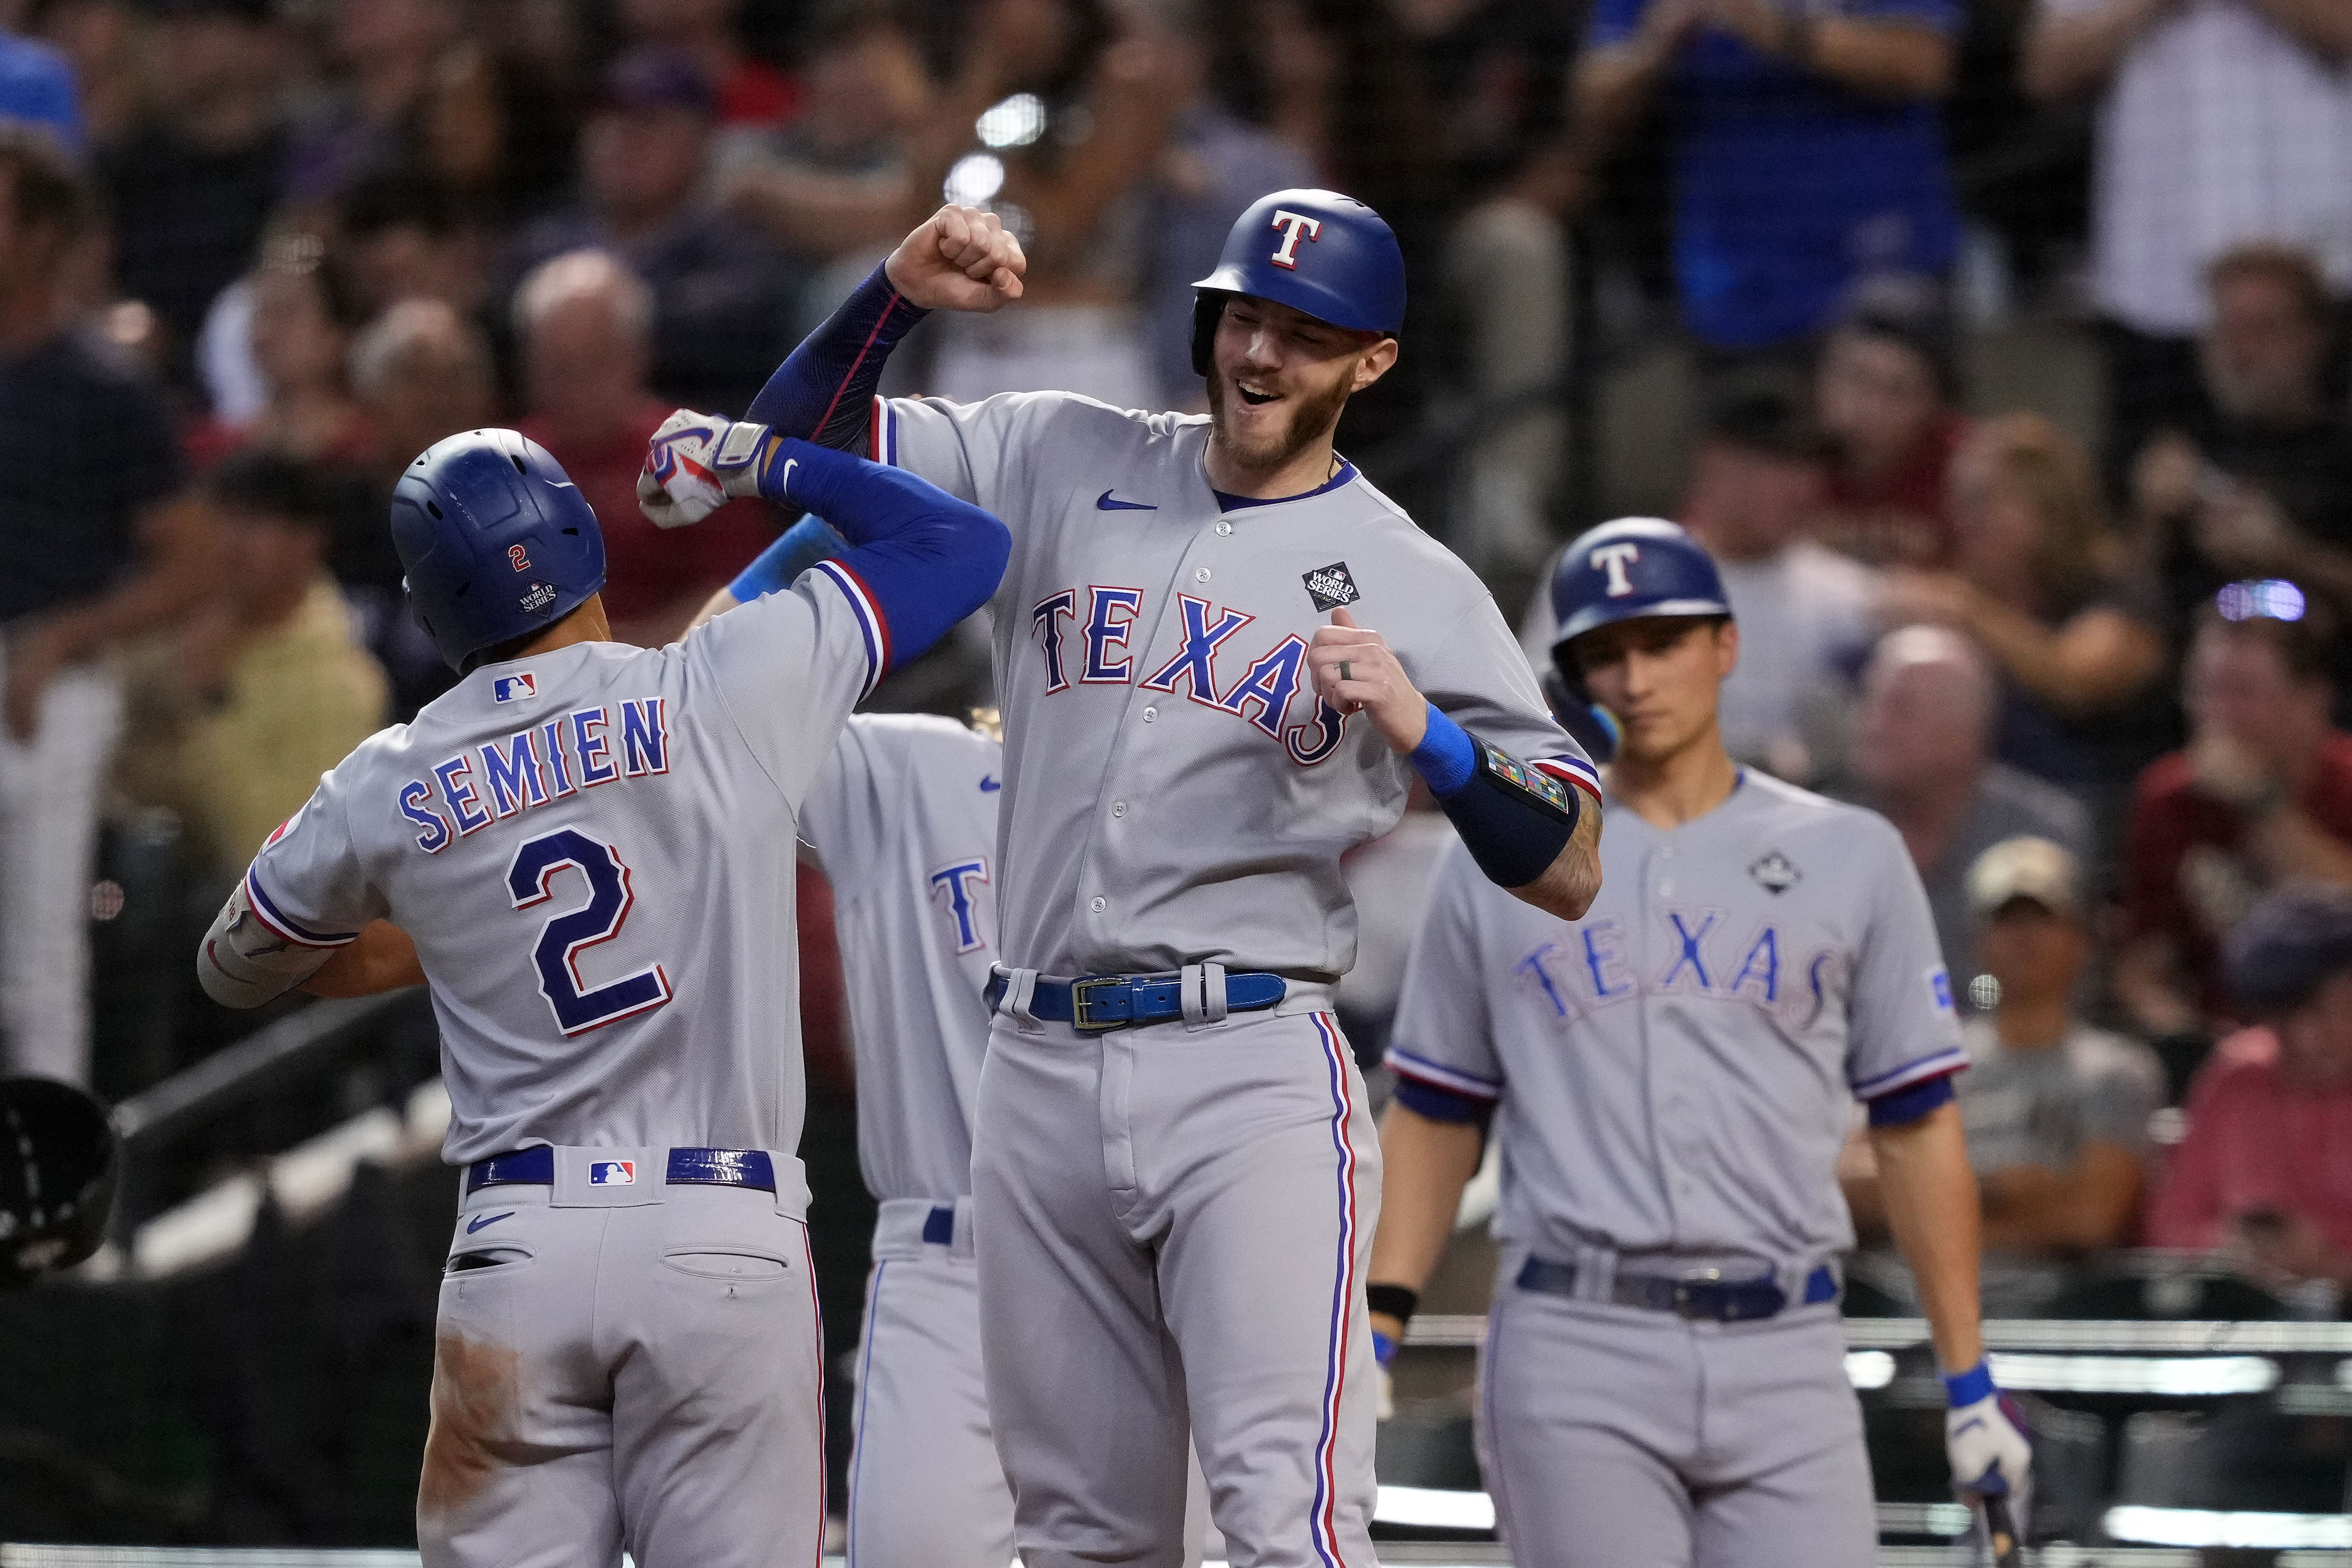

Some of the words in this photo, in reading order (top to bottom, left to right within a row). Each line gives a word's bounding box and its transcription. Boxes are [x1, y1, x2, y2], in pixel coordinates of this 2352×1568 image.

[1271, 210, 1323, 270] T
[508, 544, 531, 572] 2
[1590, 542, 1640, 599] T
[520, 584, 553, 605] WORLD
[524, 591, 556, 612] SERIES
[1308, 580, 1350, 603] SERIES
[1313, 571, 1354, 594] WORLD
[397, 696, 670, 855] SEMIEN
[504, 824, 673, 1038] 2
[1514, 907, 1834, 1030] TEXAS
